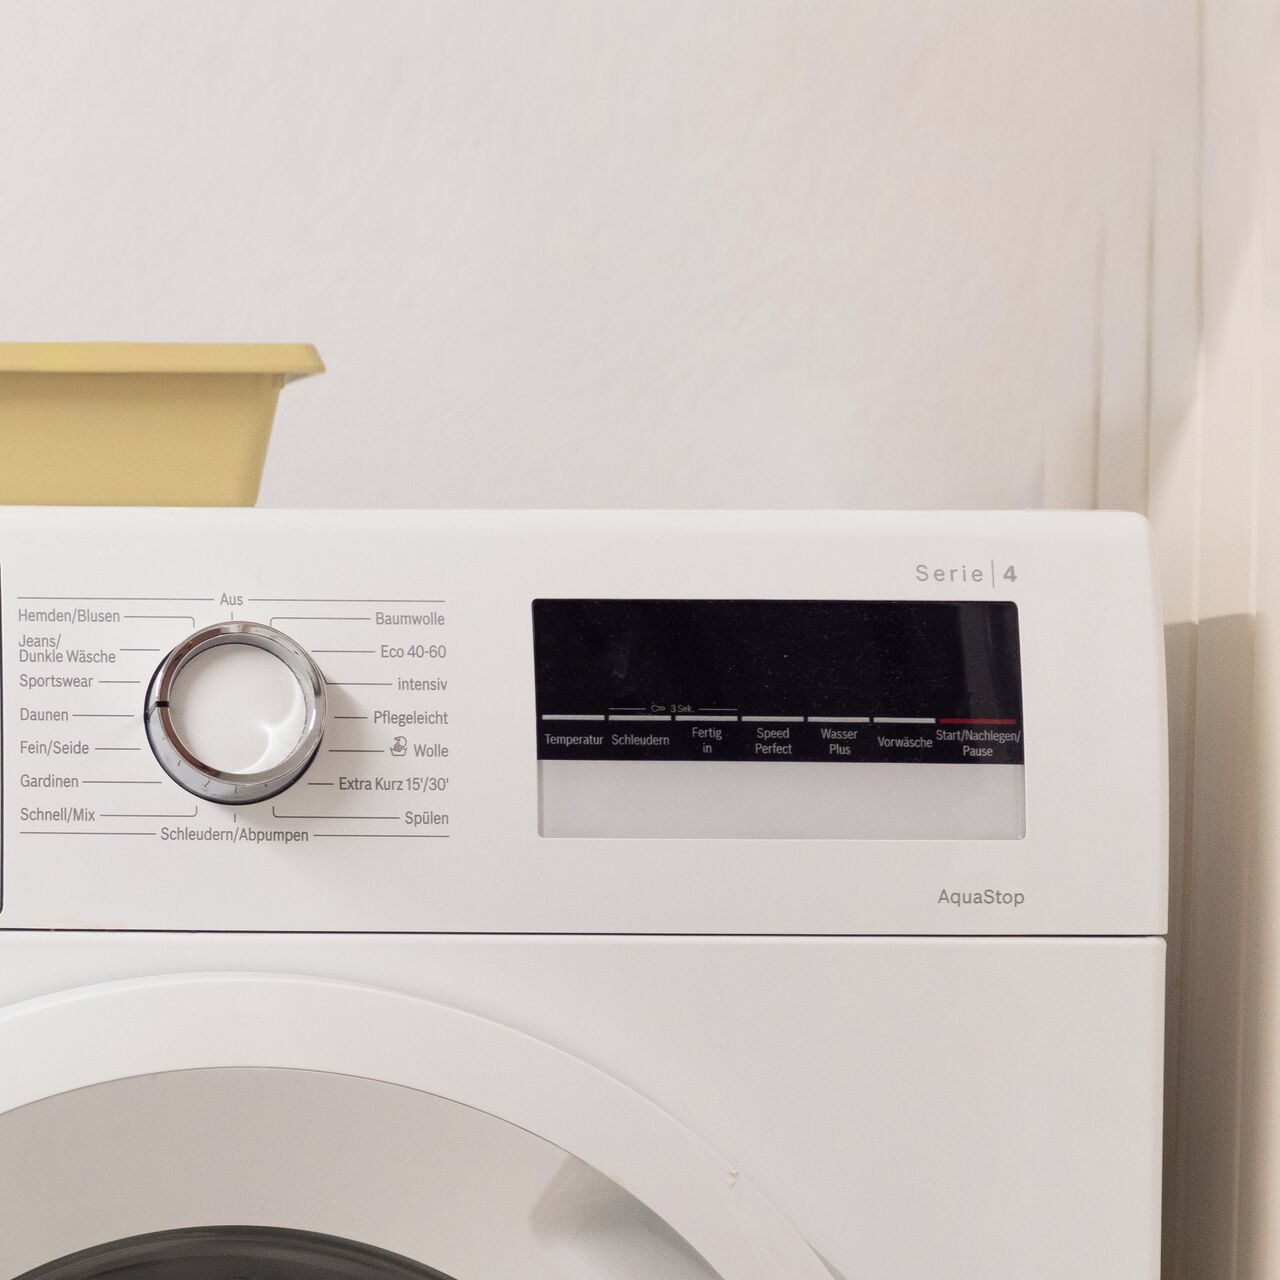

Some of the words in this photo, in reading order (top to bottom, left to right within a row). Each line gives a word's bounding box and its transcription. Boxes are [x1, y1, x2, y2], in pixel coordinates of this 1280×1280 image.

[915, 564, 984, 583] Serie
[1003, 564, 1018, 583] 4
[220, 593, 244, 606] Aus
[18, 609, 121, 623] Hemden/Blusen
[375, 612, 445, 625] Baumwolle
[18, 634, 61, 649] Jeans/
[19, 650, 63, 663] Dunkle
[67, 649, 116, 663] Wäsche
[381, 645, 404, 658] Eco
[407, 645, 447, 658] 40-60
[19, 675, 94, 690] Sportswear
[397, 678, 448, 690] intensiv
[19, 708, 69, 721] Daunen
[670, 705, 676, 713] 3
[678, 705, 695, 713] Sek.
[373, 711, 448, 726] Pflegeleicht
[545, 734, 604, 748] Temperatur
[611, 733, 670, 746] Schleudern
[691, 727, 722, 742] Fertig
[756, 727, 790, 742] Speed
[820, 728, 858, 741] Wasser
[936, 728, 1021, 744] Start/Nachlegen/
[19, 741, 90, 755] Fein/Seide
[702, 743, 712, 754] in
[755, 743, 792, 755] Perfect
[877, 735, 933, 749] Vorwäsche
[413, 744, 449, 757] Wolle
[829, 744, 851, 756] Plus
[962, 744, 993, 757] Pause
[19, 774, 79, 788] Gardinen
[339, 778, 372, 791] Extra
[375, 778, 402, 791] Kurz
[405, 777, 449, 792] 15'/30'
[20, 808, 96, 822] Schnell/Mix
[405, 811, 449, 826] Spülen
[160, 827, 309, 842] Schleudern/Abpumpen
[937, 889, 1025, 906] AquaStop
